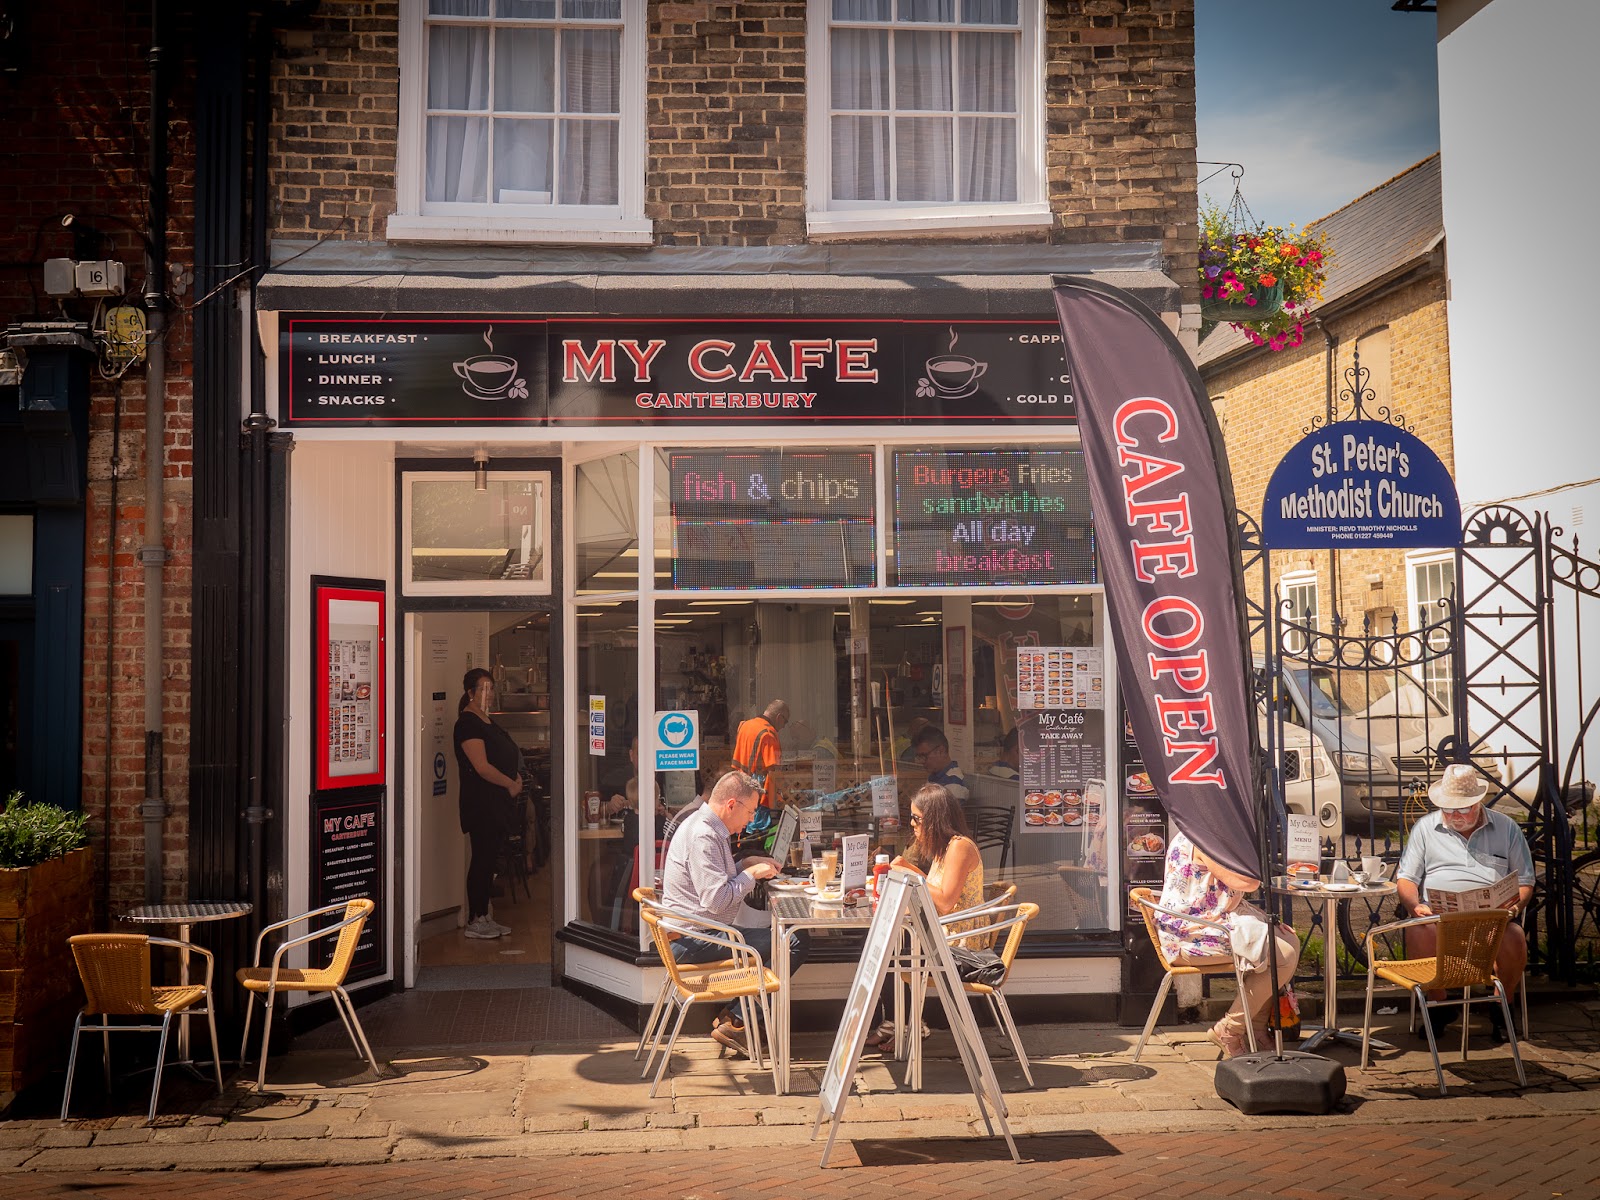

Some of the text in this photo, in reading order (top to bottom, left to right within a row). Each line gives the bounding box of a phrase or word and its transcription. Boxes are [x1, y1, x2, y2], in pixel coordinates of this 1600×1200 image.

[90, 270, 103, 282] 16
[319, 334, 418, 344] BREAKFAST
[319, 354, 376, 364] LUNCH
[562, 338, 878, 384] MY CAFE
[319, 375, 382, 385] DINNER
[318, 396, 385, 405] SNACKS
[635, 392, 818, 409] CANTERBURY
[1016, 394, 1058, 404] COLD
[1311, 434, 1410, 478] St. Peter's
[914, 464, 1073, 489] Burgers Fries
[683, 471, 858, 505] fish & chips
[1112, 396, 1199, 584] CAFE
[1281, 478, 1443, 519] Methodist Church
[923, 490, 1065, 514] sandwiches
[952, 520, 1036, 546] All day
[936, 549, 1055, 572] breakfast
[1142, 595, 1228, 790] OPEN
[1038, 712, 1084, 728] My Café
[324, 812, 375, 833] MY CAFE
[1290, 820, 1317, 829] My Café
[847, 843, 856, 852] My
